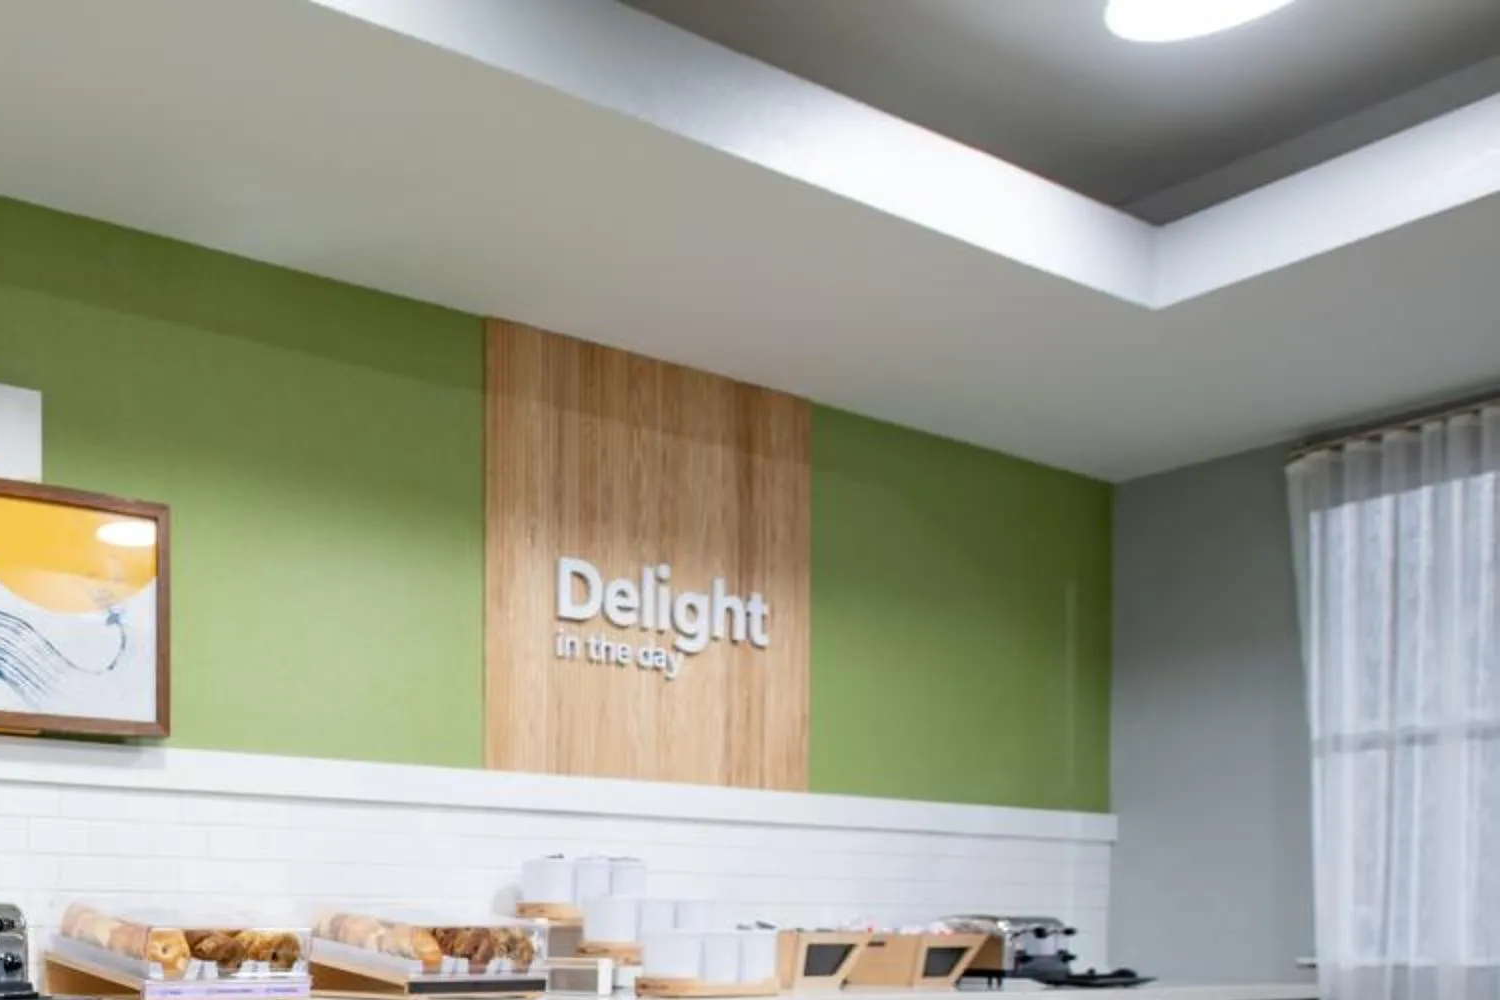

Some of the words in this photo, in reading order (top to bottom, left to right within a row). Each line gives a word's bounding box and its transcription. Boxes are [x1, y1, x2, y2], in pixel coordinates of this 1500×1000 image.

[557, 556, 771, 654] Delight
[555, 629, 580, 659] in
[586, 633, 633, 667] the
[637, 637, 685, 682] day
